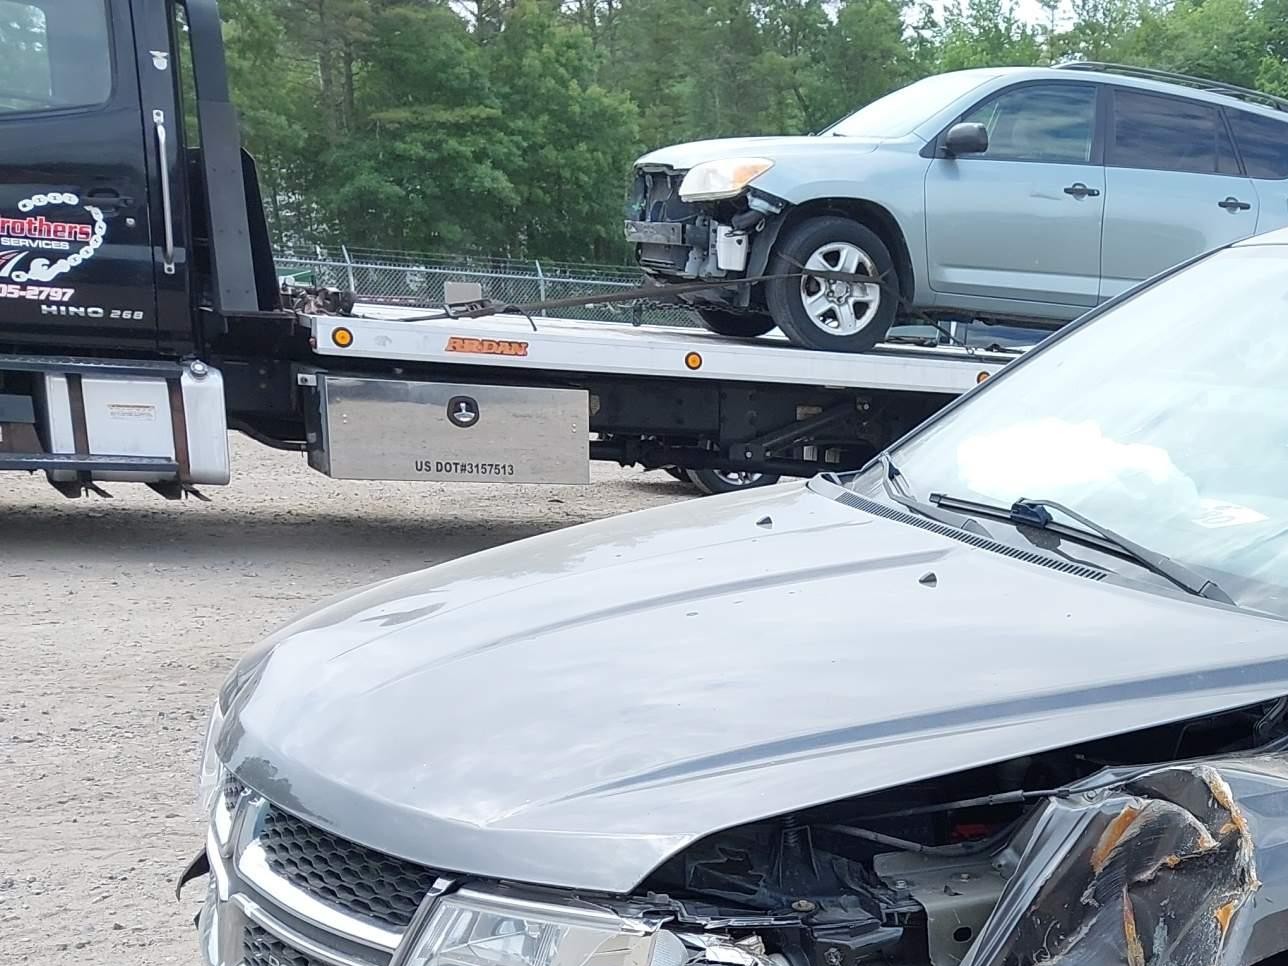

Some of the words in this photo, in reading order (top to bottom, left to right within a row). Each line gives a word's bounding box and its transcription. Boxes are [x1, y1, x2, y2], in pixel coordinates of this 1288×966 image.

[0, 215, 92, 241] rothers
[1, 237, 70, 250] SERVICES
[41, 304, 104, 318] HINO
[110, 309, 143, 320] 268
[415, 460, 431, 472] US
[435, 461, 514, 476] DOT#3157513
